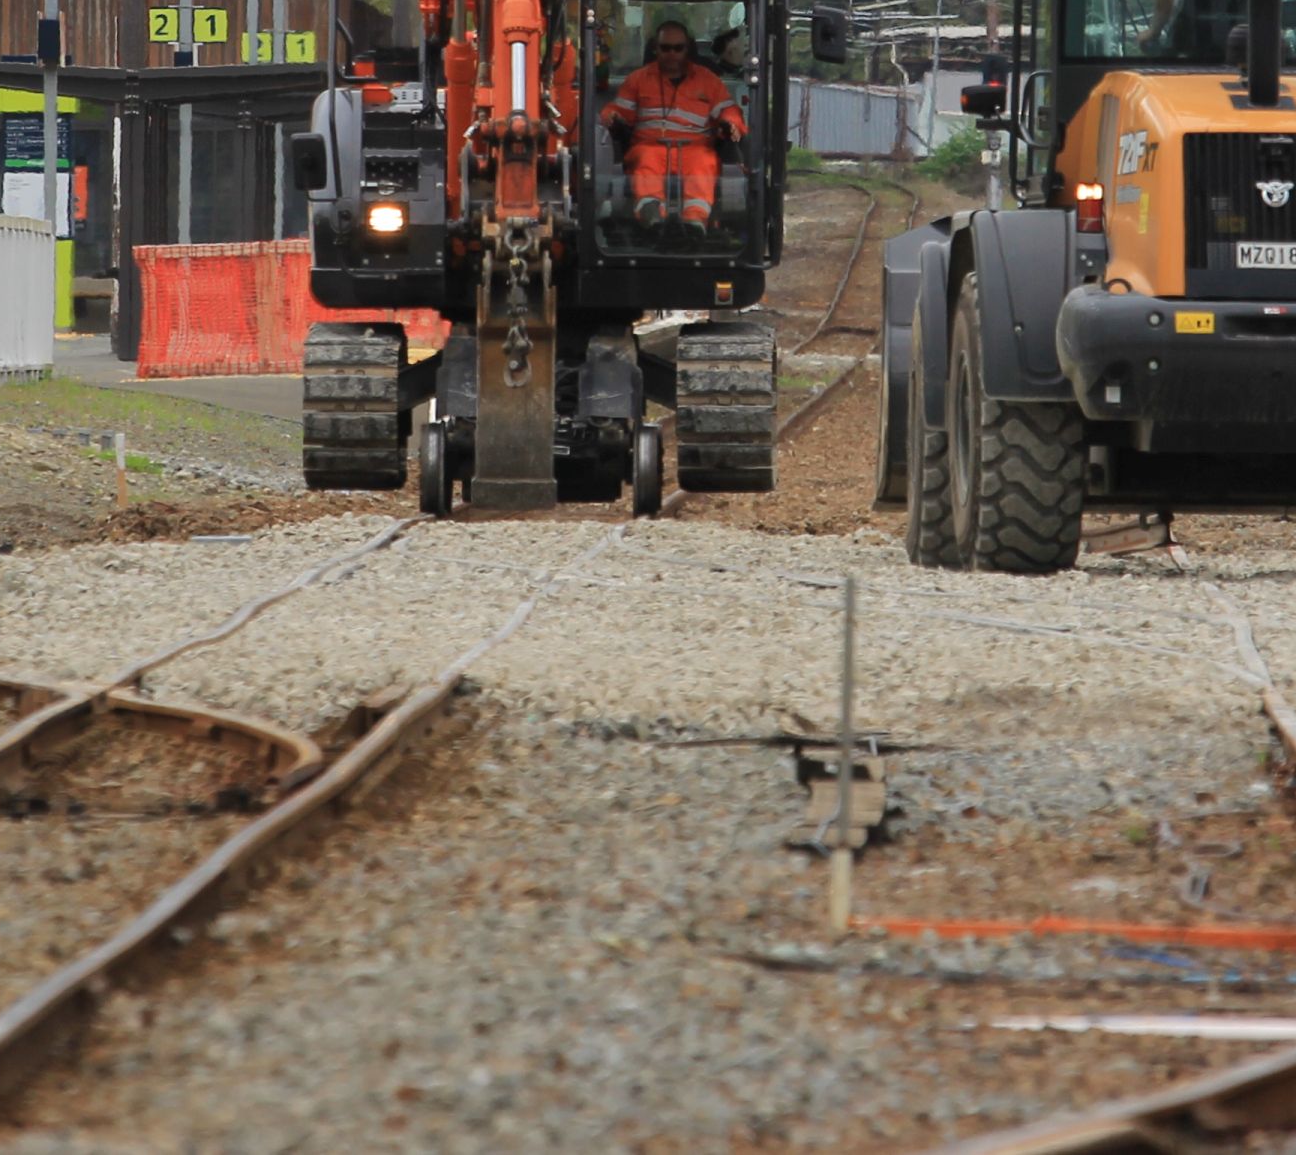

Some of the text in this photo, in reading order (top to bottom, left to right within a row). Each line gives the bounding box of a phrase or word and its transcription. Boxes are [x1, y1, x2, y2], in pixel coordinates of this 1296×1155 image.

[154, 13, 169, 36] 2
[205, 14, 217, 37] 1
[296, 38, 306, 57] 1
